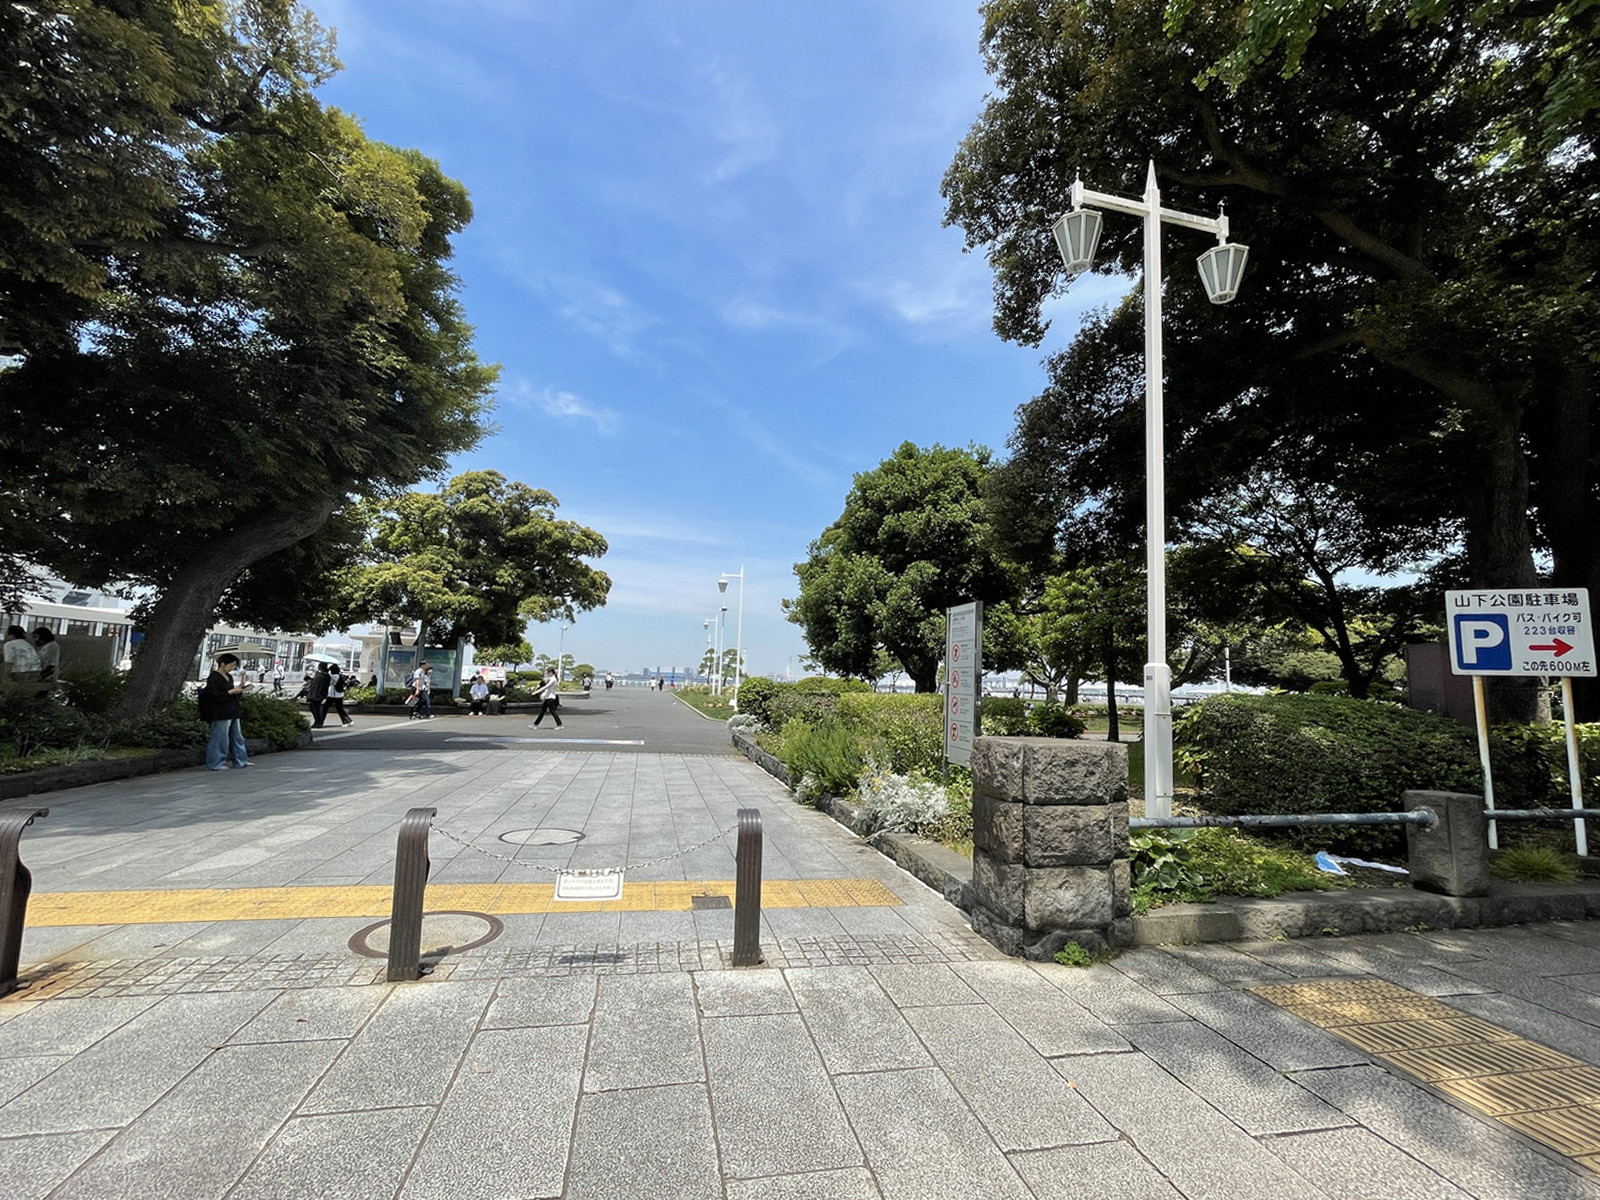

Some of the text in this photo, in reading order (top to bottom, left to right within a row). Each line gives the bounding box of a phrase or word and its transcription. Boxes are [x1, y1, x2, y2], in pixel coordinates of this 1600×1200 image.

[1455, 593, 1579, 607] 山下公園駐車場
[1523, 626, 1575, 635] 223台収容
[1460, 620, 1504, 664] P
